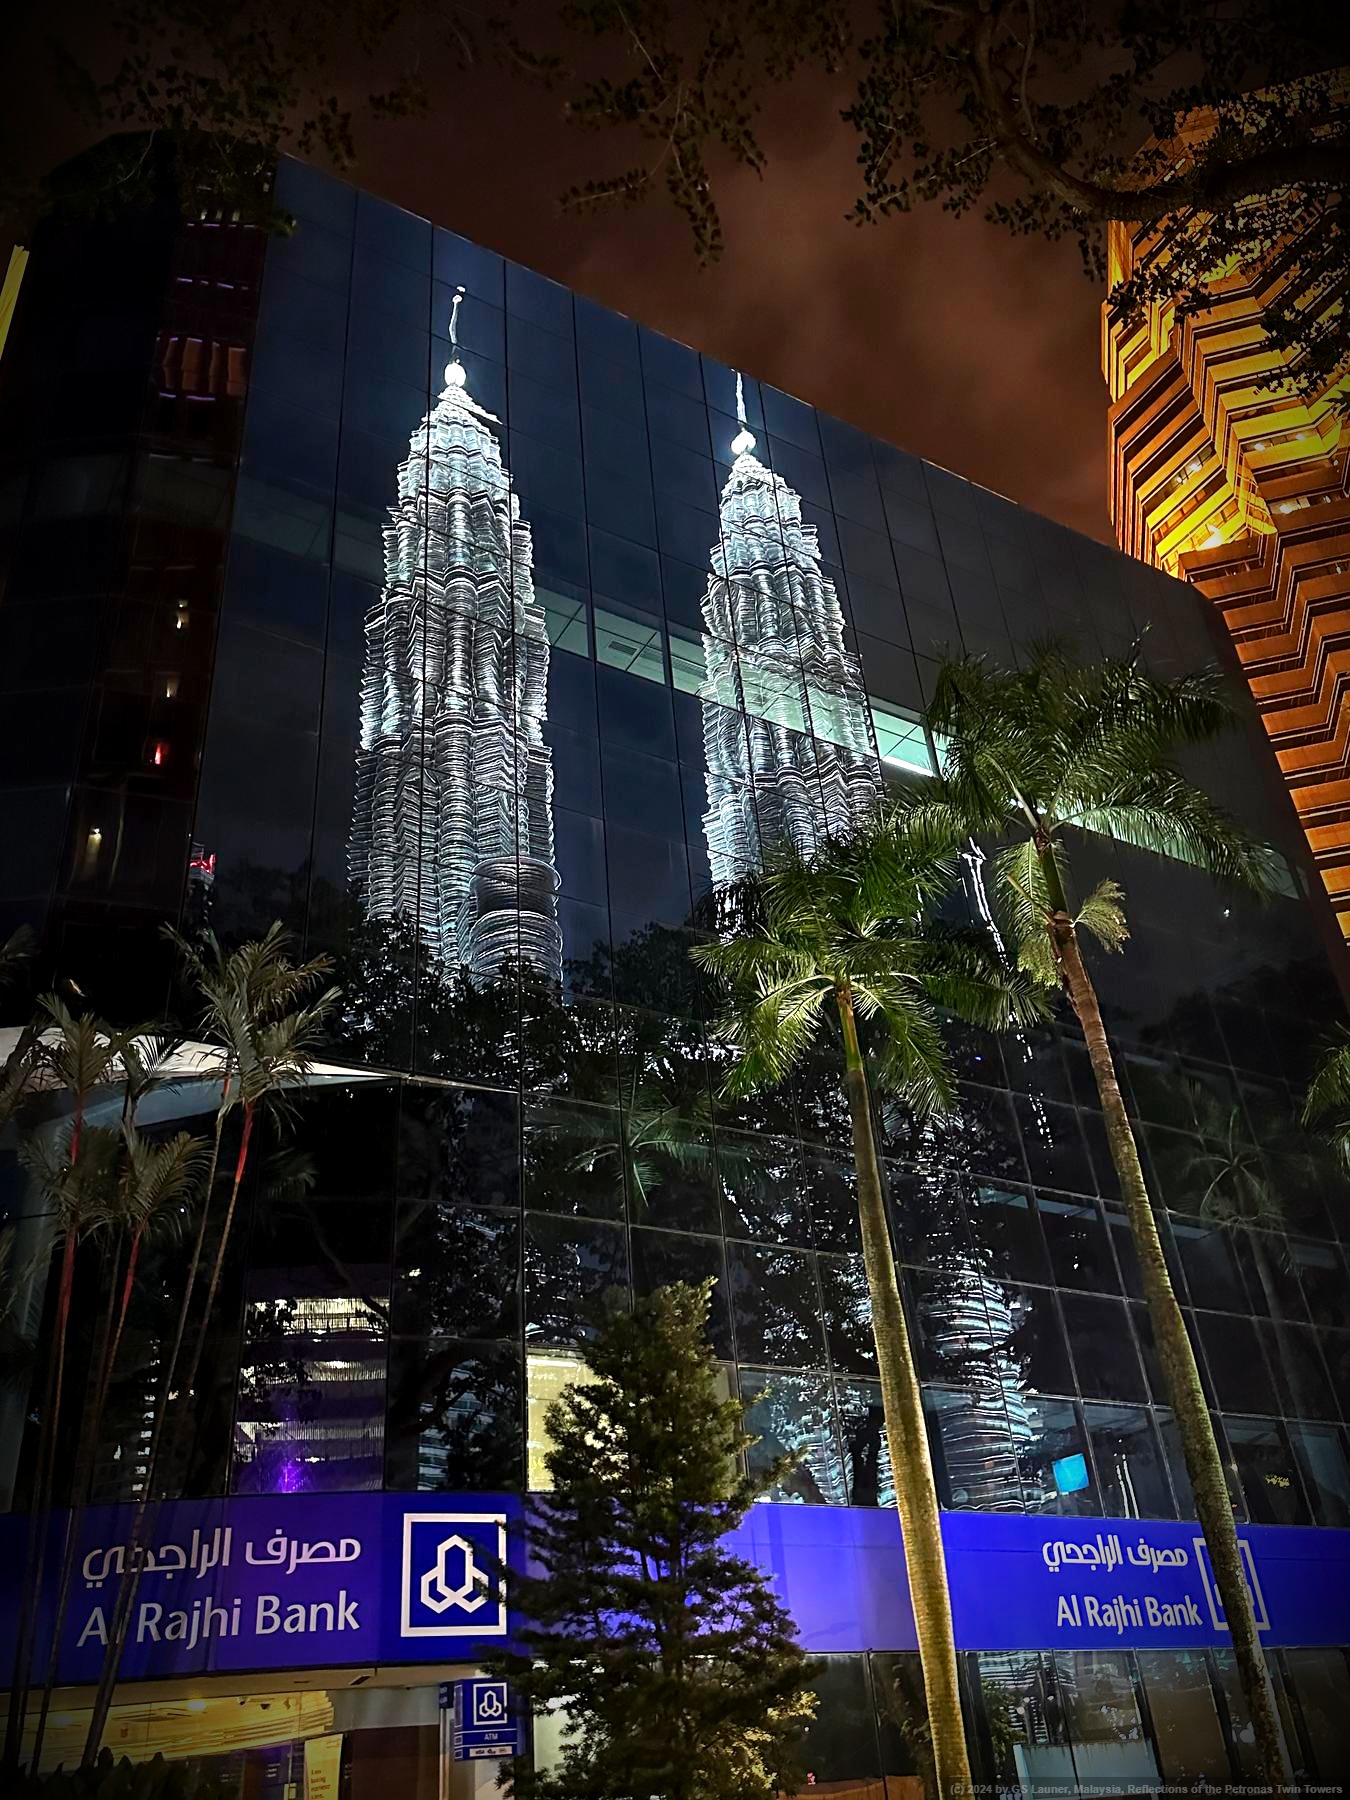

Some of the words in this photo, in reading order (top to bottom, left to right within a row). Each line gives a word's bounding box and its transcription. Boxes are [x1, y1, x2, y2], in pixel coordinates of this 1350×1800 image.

[245, 1528, 362, 1575] مصرف
[1042, 1534, 1124, 1573] الراجحي
[1126, 1537, 1189, 1574] مصرف
[136, 1596, 242, 1650] Rajhi
[256, 1590, 361, 1635] Bank
[1056, 1594, 1082, 1627] Al
[1083, 1595, 1144, 1636] Rajhi
[1144, 1594, 1204, 1627] Bank
[483, 1732, 499, 1741] ATM
